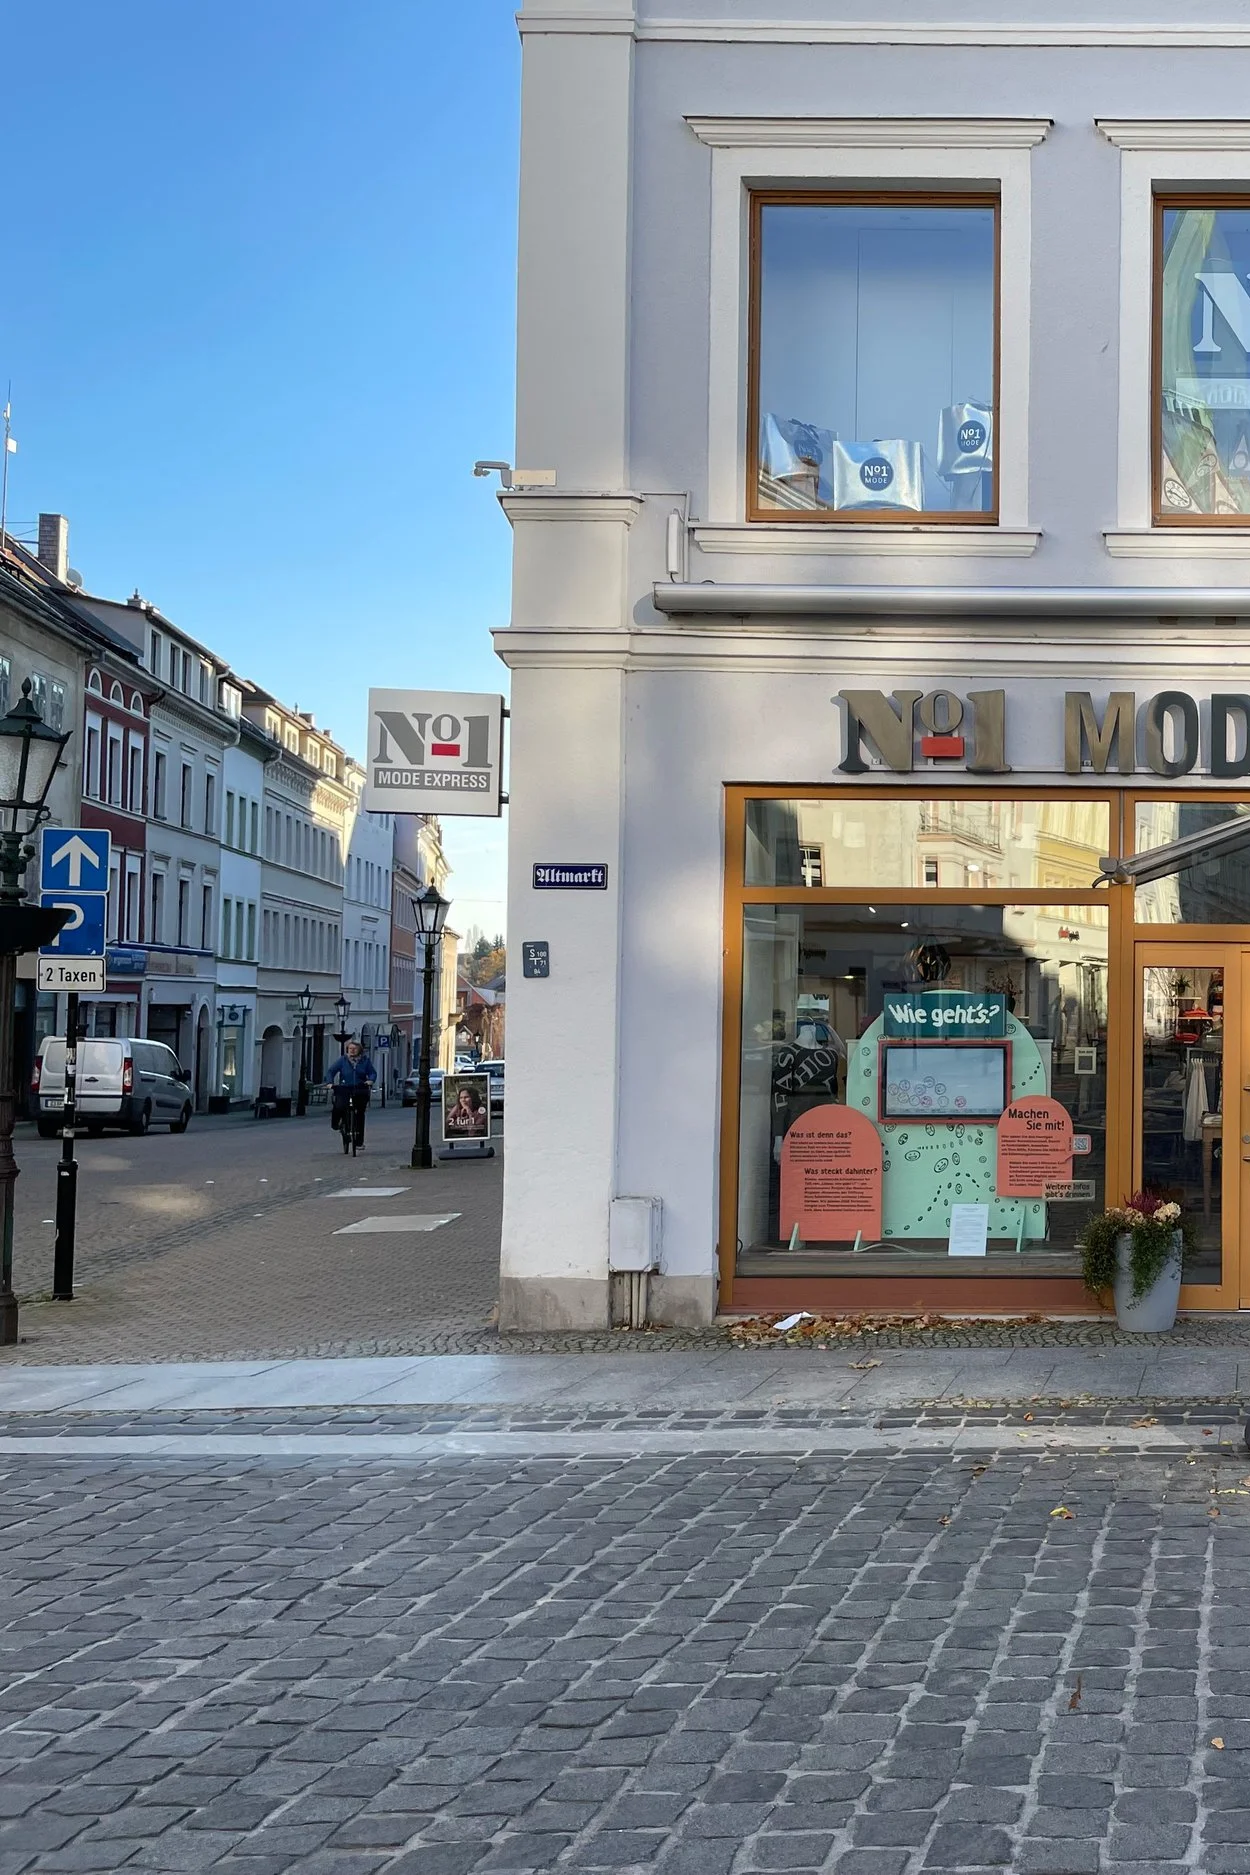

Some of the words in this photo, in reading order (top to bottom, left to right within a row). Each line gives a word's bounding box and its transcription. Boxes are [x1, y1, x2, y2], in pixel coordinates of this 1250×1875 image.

[378, 771, 421, 786] MODE
[424, 772, 488, 788] EXPRESS
[536, 868, 603, 883] Altmarkt
[46, 967, 53, 982] 2
[58, 967, 96, 982] Taxen
[888, 1002, 927, 1024] Wie
[931, 1003, 1000, 1027] geht's?
[380, 1036, 389, 1046] P
[1008, 1108, 1049, 1119] Machen
[449, 1118, 454, 1126] 2
[1026, 1120, 1042, 1131] Sie
[1045, 1120, 1065, 1131] mit!
[845, 1167, 878, 1175] dahinter?
